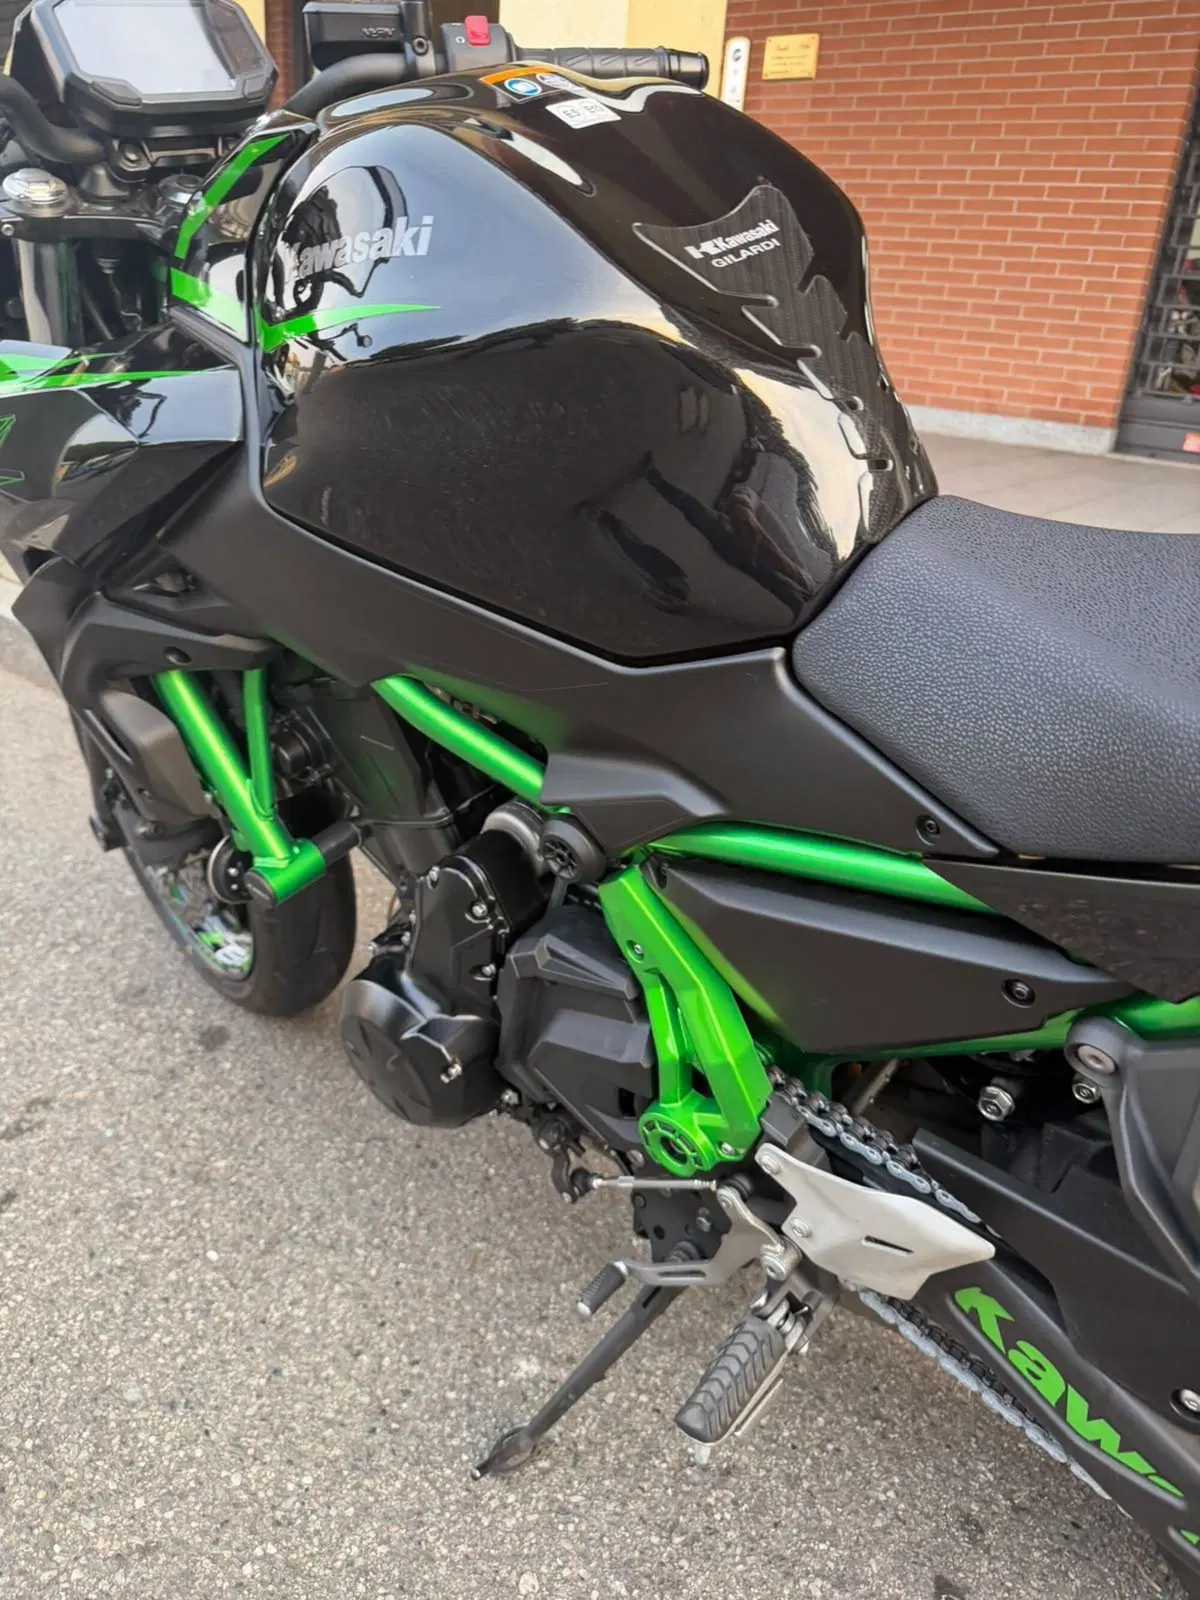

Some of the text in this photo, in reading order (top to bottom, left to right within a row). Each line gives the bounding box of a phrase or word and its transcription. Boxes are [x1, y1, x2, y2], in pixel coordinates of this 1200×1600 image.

[278, 215, 434, 282] Kawasaki
[711, 238, 781, 267] GILARDI
[712, 219, 780, 251] Kawasaki
[954, 1287, 1184, 1497] Kaw
